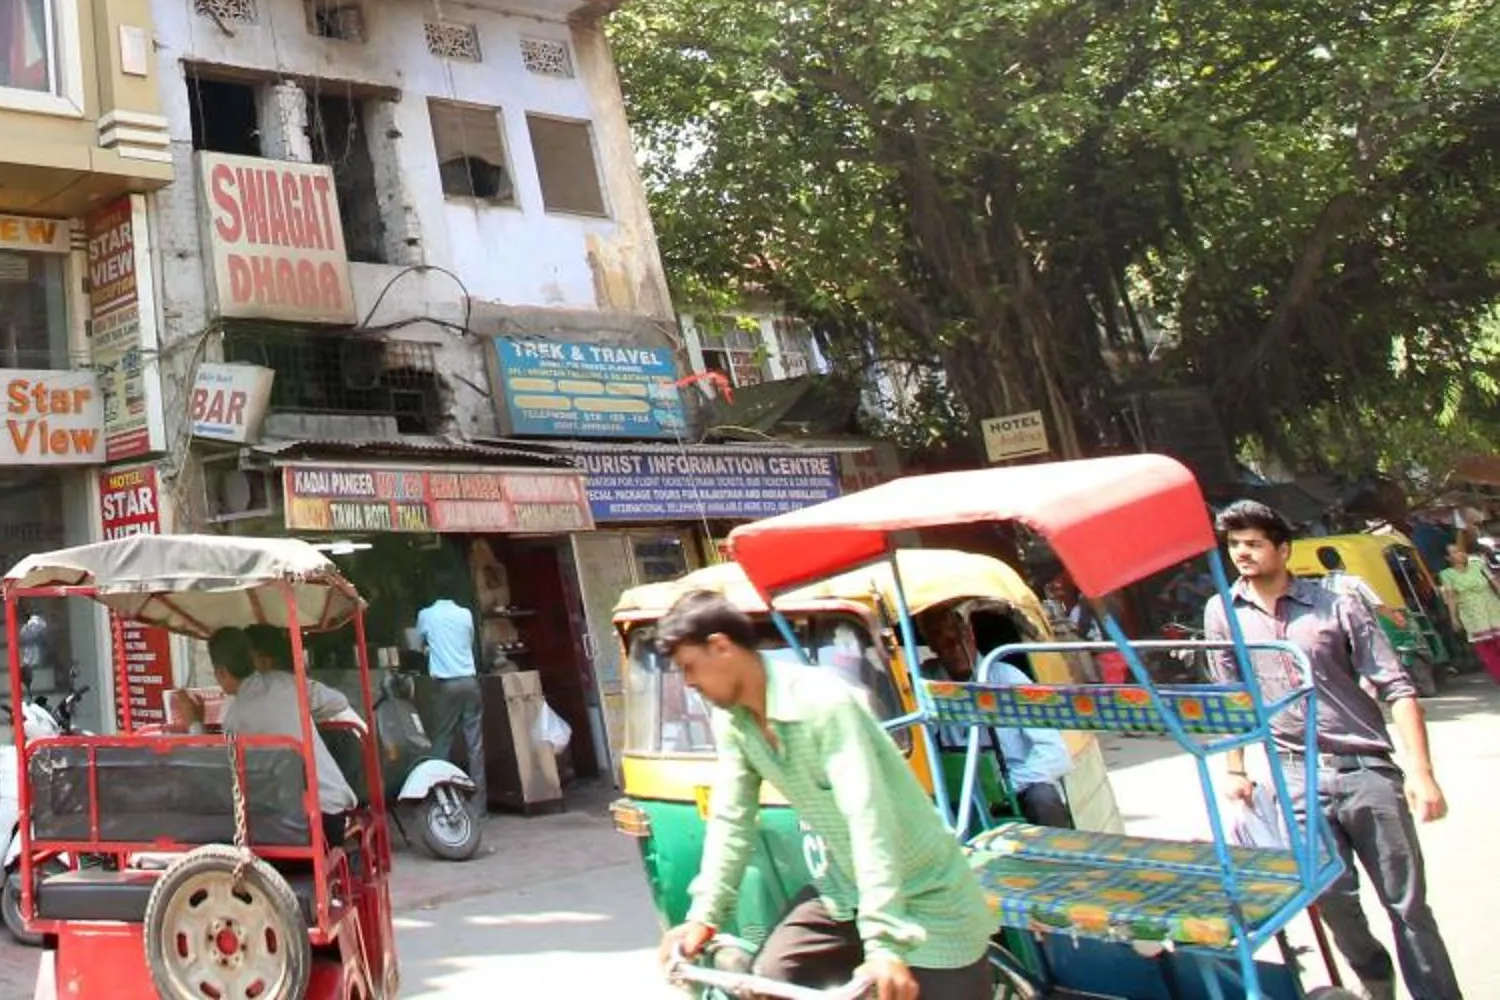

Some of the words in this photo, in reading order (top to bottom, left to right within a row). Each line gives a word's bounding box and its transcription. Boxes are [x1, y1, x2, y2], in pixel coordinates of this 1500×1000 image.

[212, 164, 334, 250] SWAGAT
[89, 222, 132, 260] STAR
[91, 249, 134, 286] VIEW
[510, 342, 564, 361] TREK
[590, 347, 663, 365] TRAVEL
[7, 379, 92, 415] Star
[191, 388, 247, 425] BAR
[989, 416, 1040, 434] HOTEL
[570, 455, 643, 474] OURIST
[650, 455, 763, 476] INFORMATION
[768, 457, 831, 476] CENTRE
[331, 472, 375, 495] PANEER
[103, 486, 155, 520] STAR
